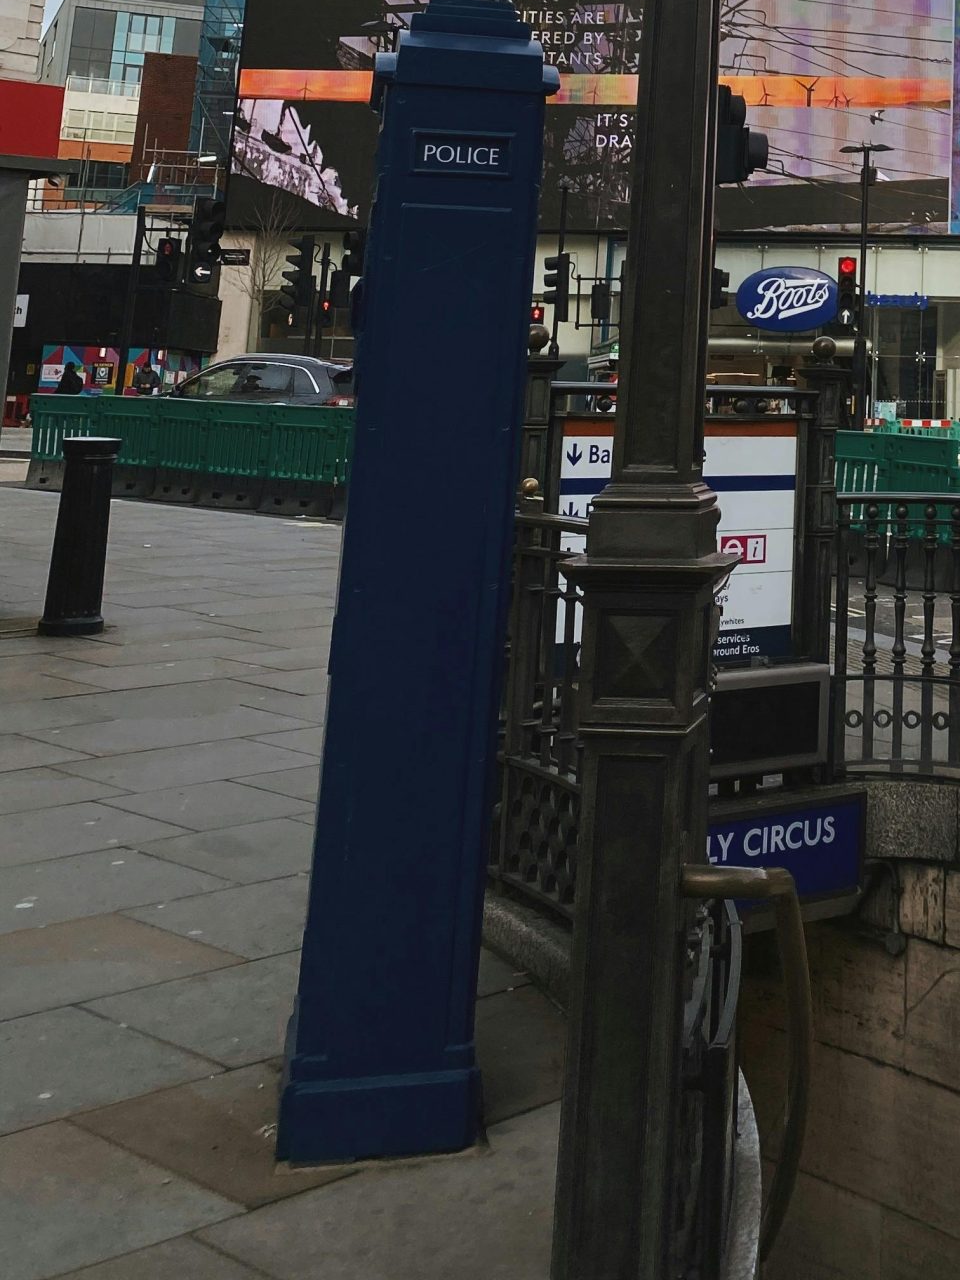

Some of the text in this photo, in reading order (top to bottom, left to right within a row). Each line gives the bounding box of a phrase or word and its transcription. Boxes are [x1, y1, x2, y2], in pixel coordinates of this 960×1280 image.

[571, 11, 605, 24] ARE
[583, 32, 605, 45] BY
[595, 134, 636, 148] DRA
[423, 144, 500, 166] POLICE
[746, 277, 830, 320] Boots
[717, 633, 751, 645] services
[742, 644, 761, 654] Eros
[743, 815, 836, 857] CIRCUS
